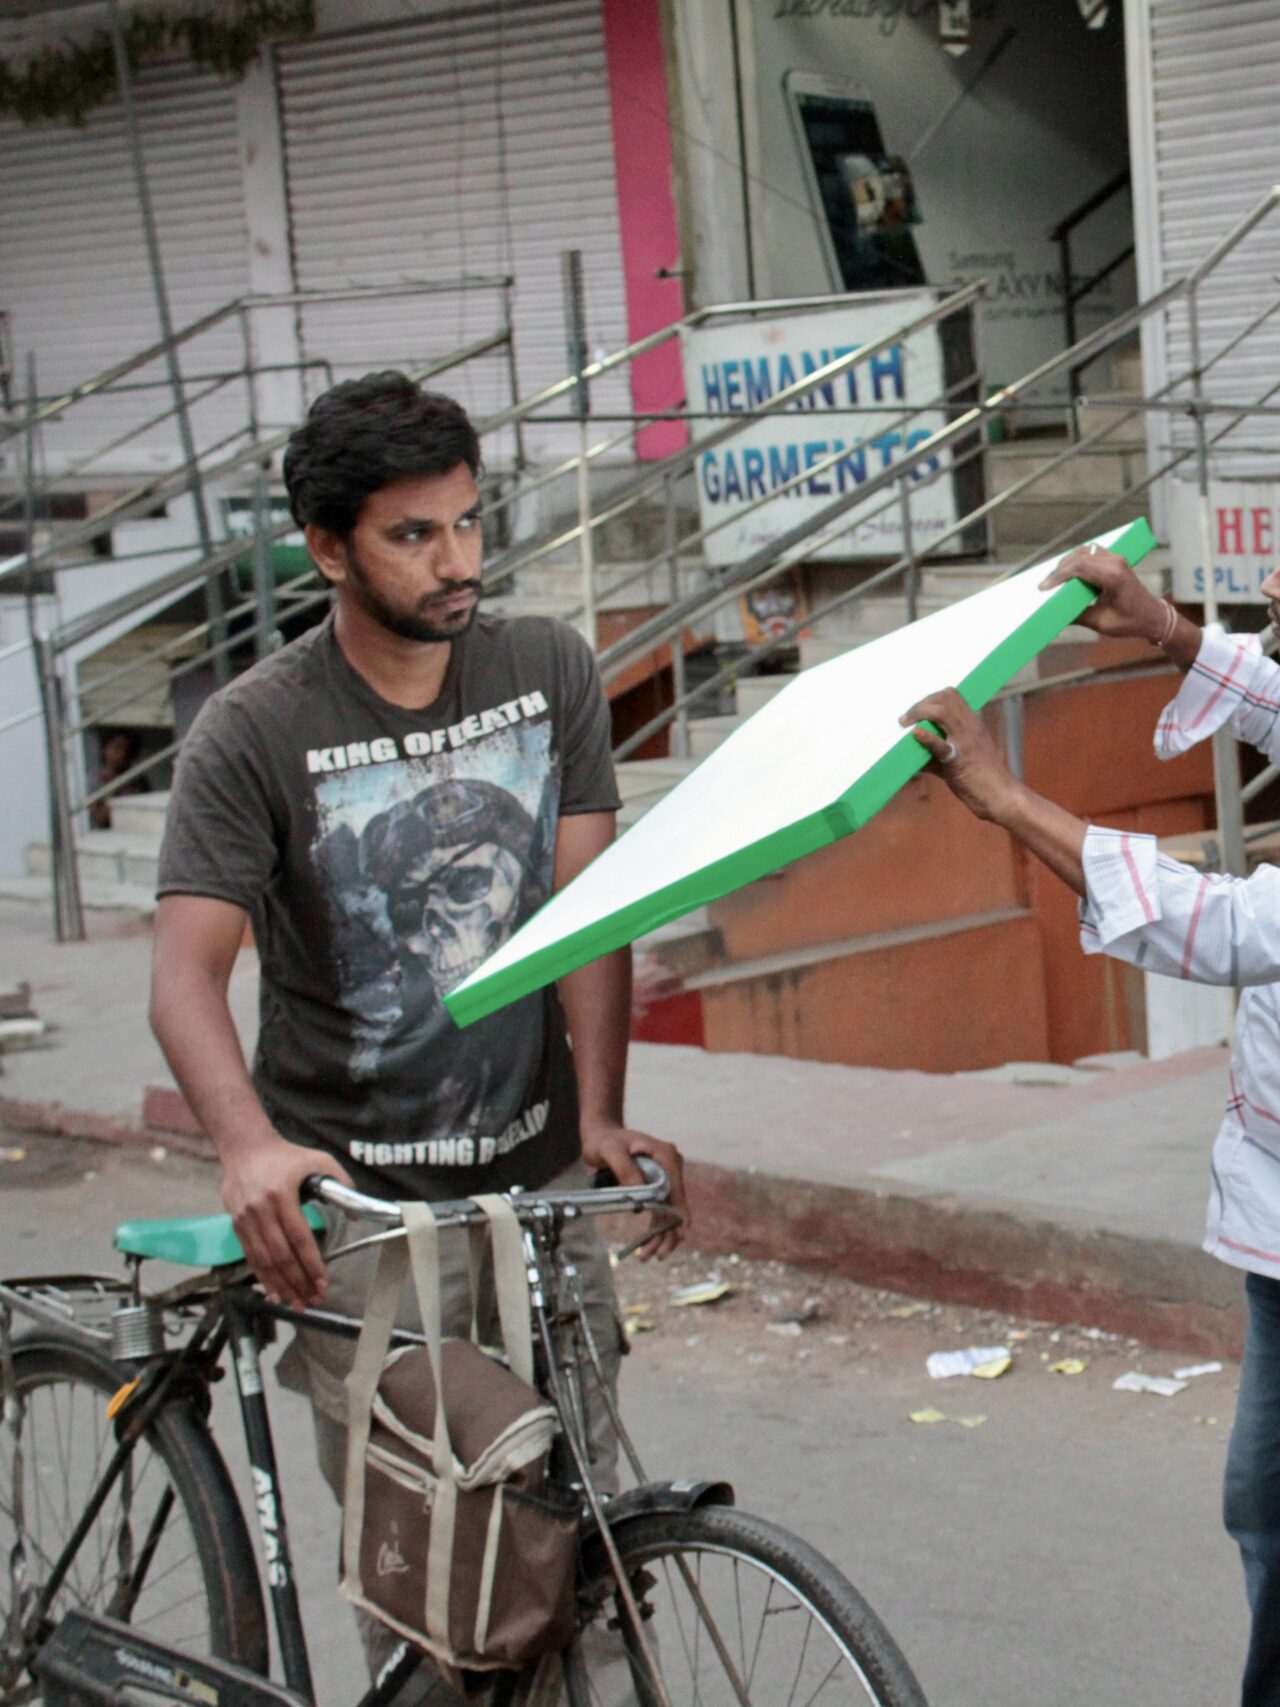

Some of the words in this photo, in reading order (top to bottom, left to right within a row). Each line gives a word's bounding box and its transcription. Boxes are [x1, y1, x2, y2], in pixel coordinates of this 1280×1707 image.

[306, 737, 398, 773] KING
[403, 729, 447, 757] OF
[350, 1137, 474, 1166] FIGHTING
